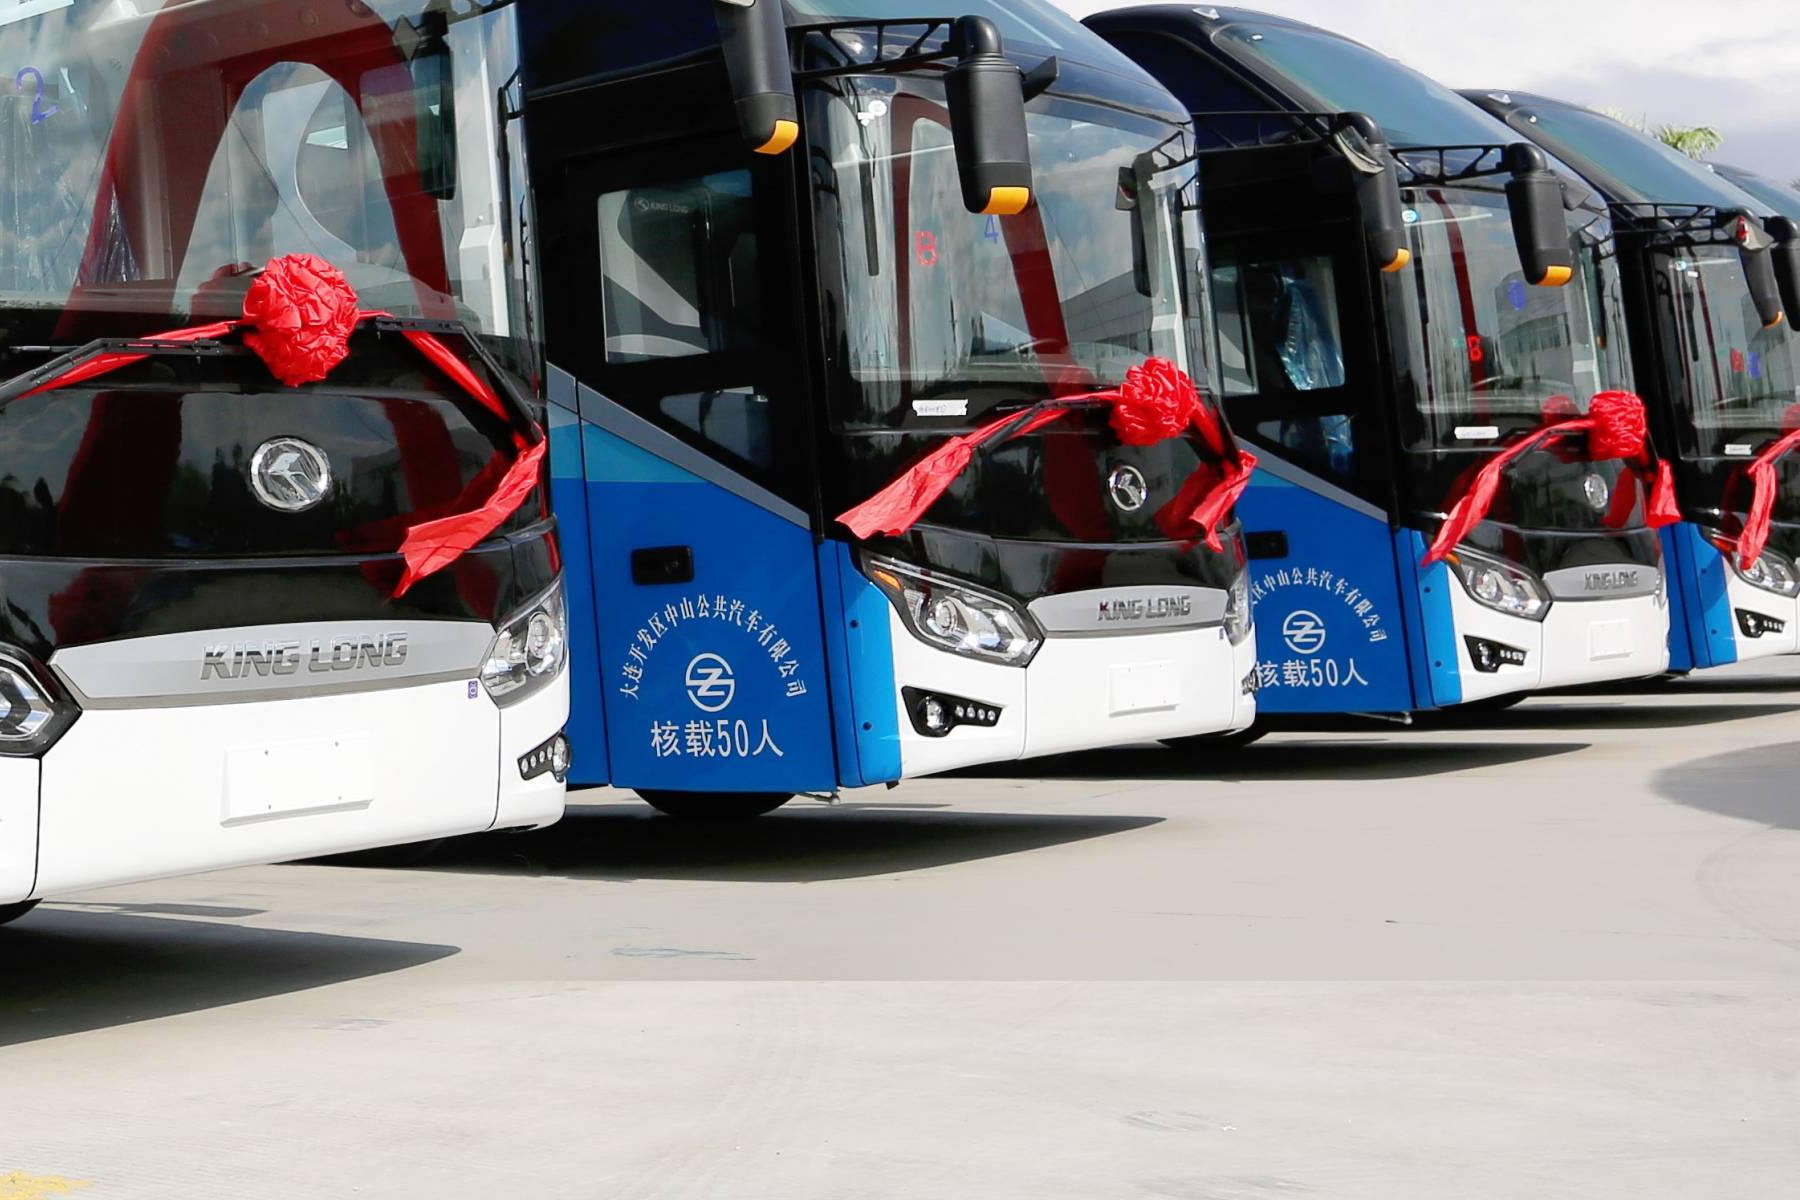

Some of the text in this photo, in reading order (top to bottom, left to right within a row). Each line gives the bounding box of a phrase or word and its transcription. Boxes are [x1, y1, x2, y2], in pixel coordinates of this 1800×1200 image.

[1098, 595, 1191, 621] KING LONG
[201, 632, 408, 680] KING LONG
[619, 593, 808, 700] 大连开发区中山公共汽车有限公司
[651, 719, 784, 758] 核载50人
